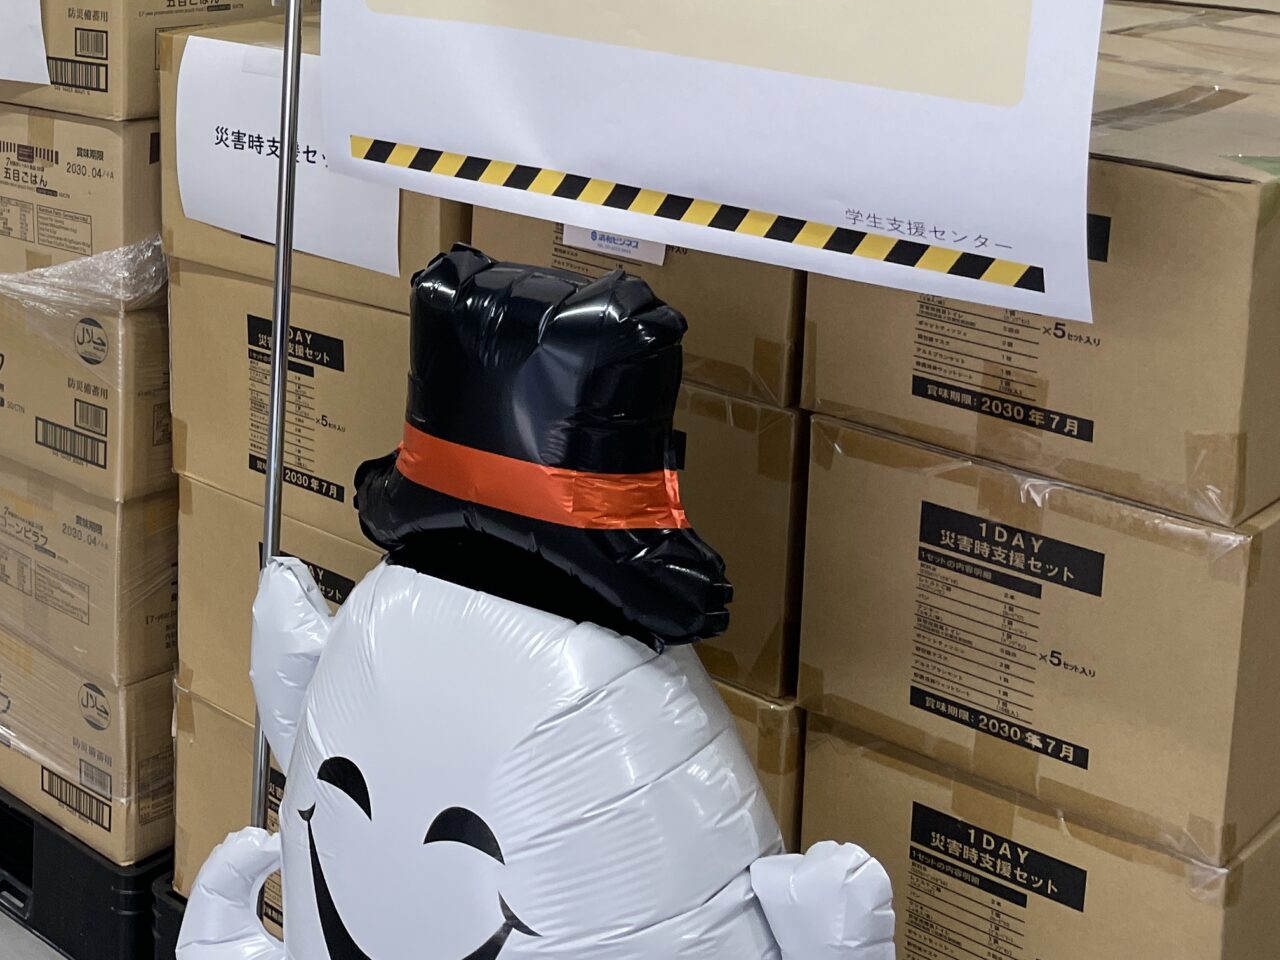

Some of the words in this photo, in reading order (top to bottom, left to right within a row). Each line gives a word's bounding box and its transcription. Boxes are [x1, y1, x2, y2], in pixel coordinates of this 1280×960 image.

[67, 7, 109, 23] 防災備蓄用
[76, 146, 105, 161] 賞味期限
[214, 125, 329, 169] 災害時支セ
[3, 167, 48, 189] 五目ごはん
[845, 208, 1013, 250] 学生支援センター
[0, 514, 49, 547] コーンピラフ
[940, 528, 1075, 583] 災害時支援セット
[930, 830, 1059, 895] 災害時支援セット
